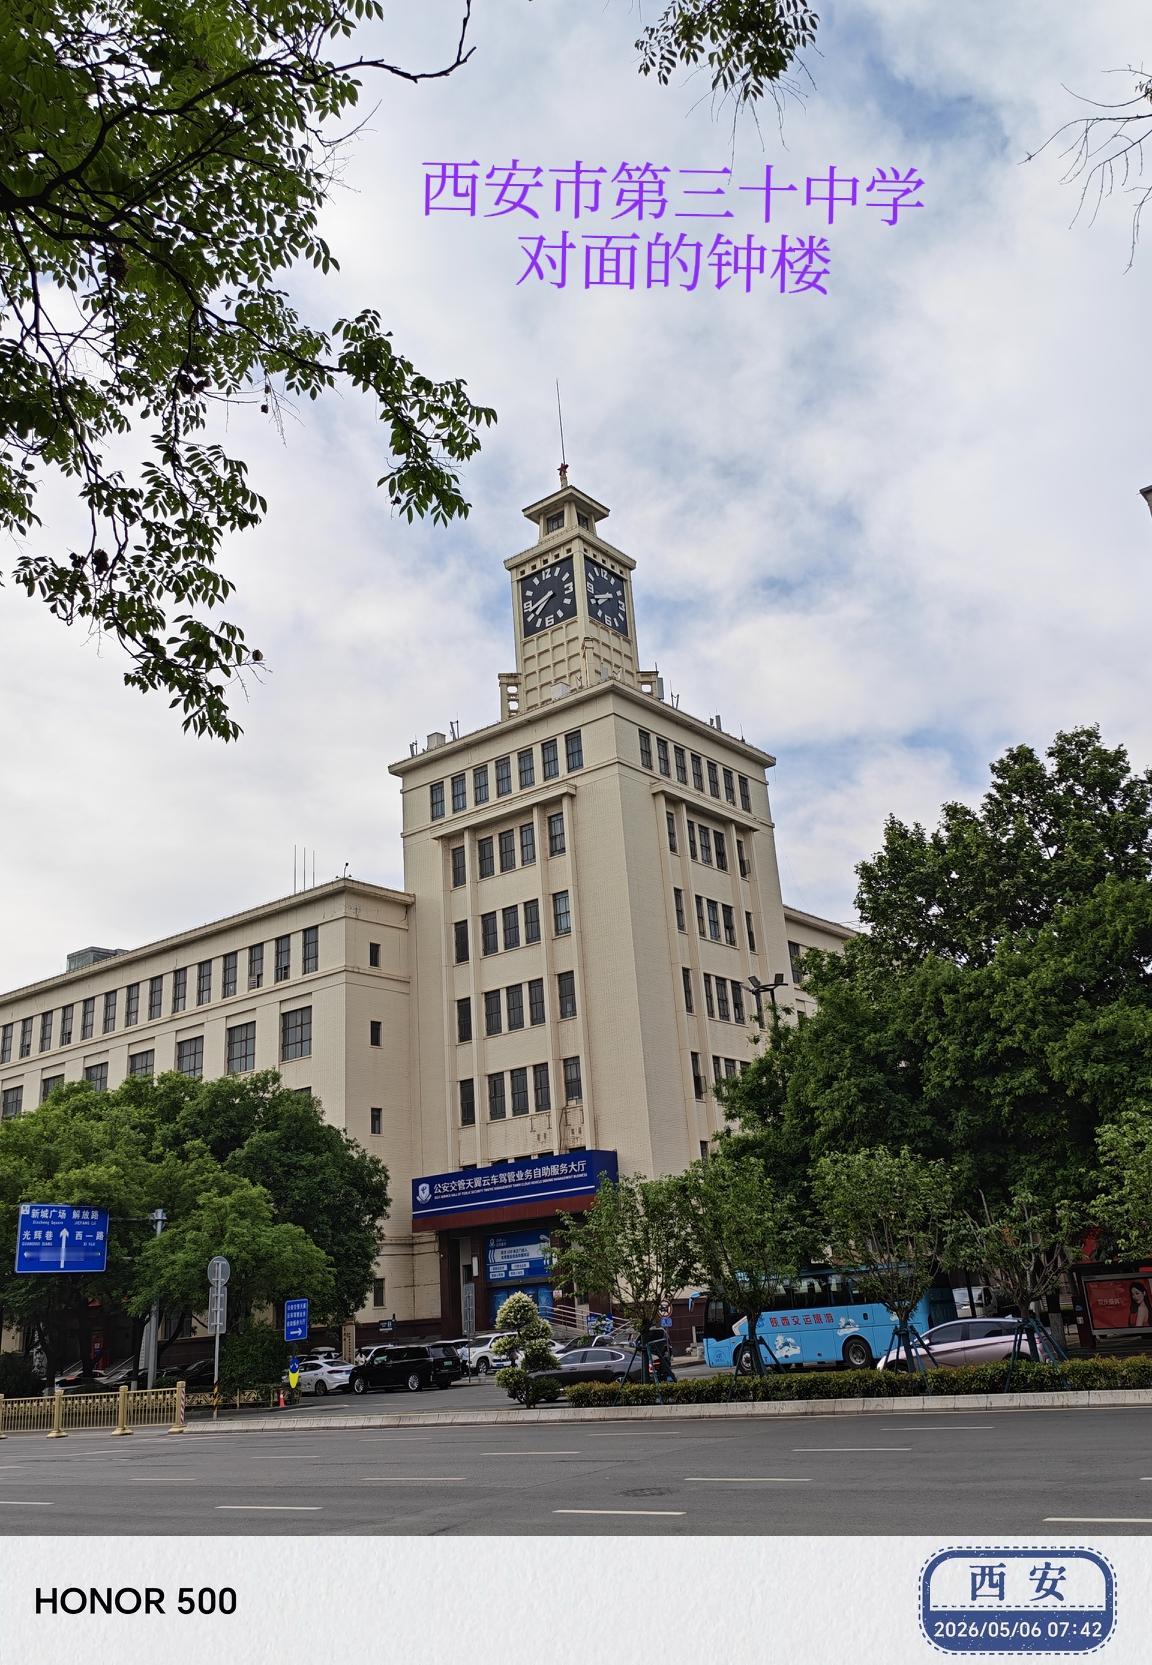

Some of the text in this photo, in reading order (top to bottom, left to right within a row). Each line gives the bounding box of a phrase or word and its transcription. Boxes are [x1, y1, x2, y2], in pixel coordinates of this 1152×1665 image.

[542, 568, 551, 580] 12
[601, 568, 608, 580] 12
[564, 581, 574, 594] 3
[586, 582, 594, 594] 9
[618, 600, 625, 612] 3
[545, 615, 554, 626] 6
[604, 615, 612, 627] 6
[433, 1160, 587, 1194] 公安交管天翼云车驾管业务自助服务大厅
[31, 1209, 99, 1220] 新城广场 解放路
[75, 1231, 104, 1240] 西一路
